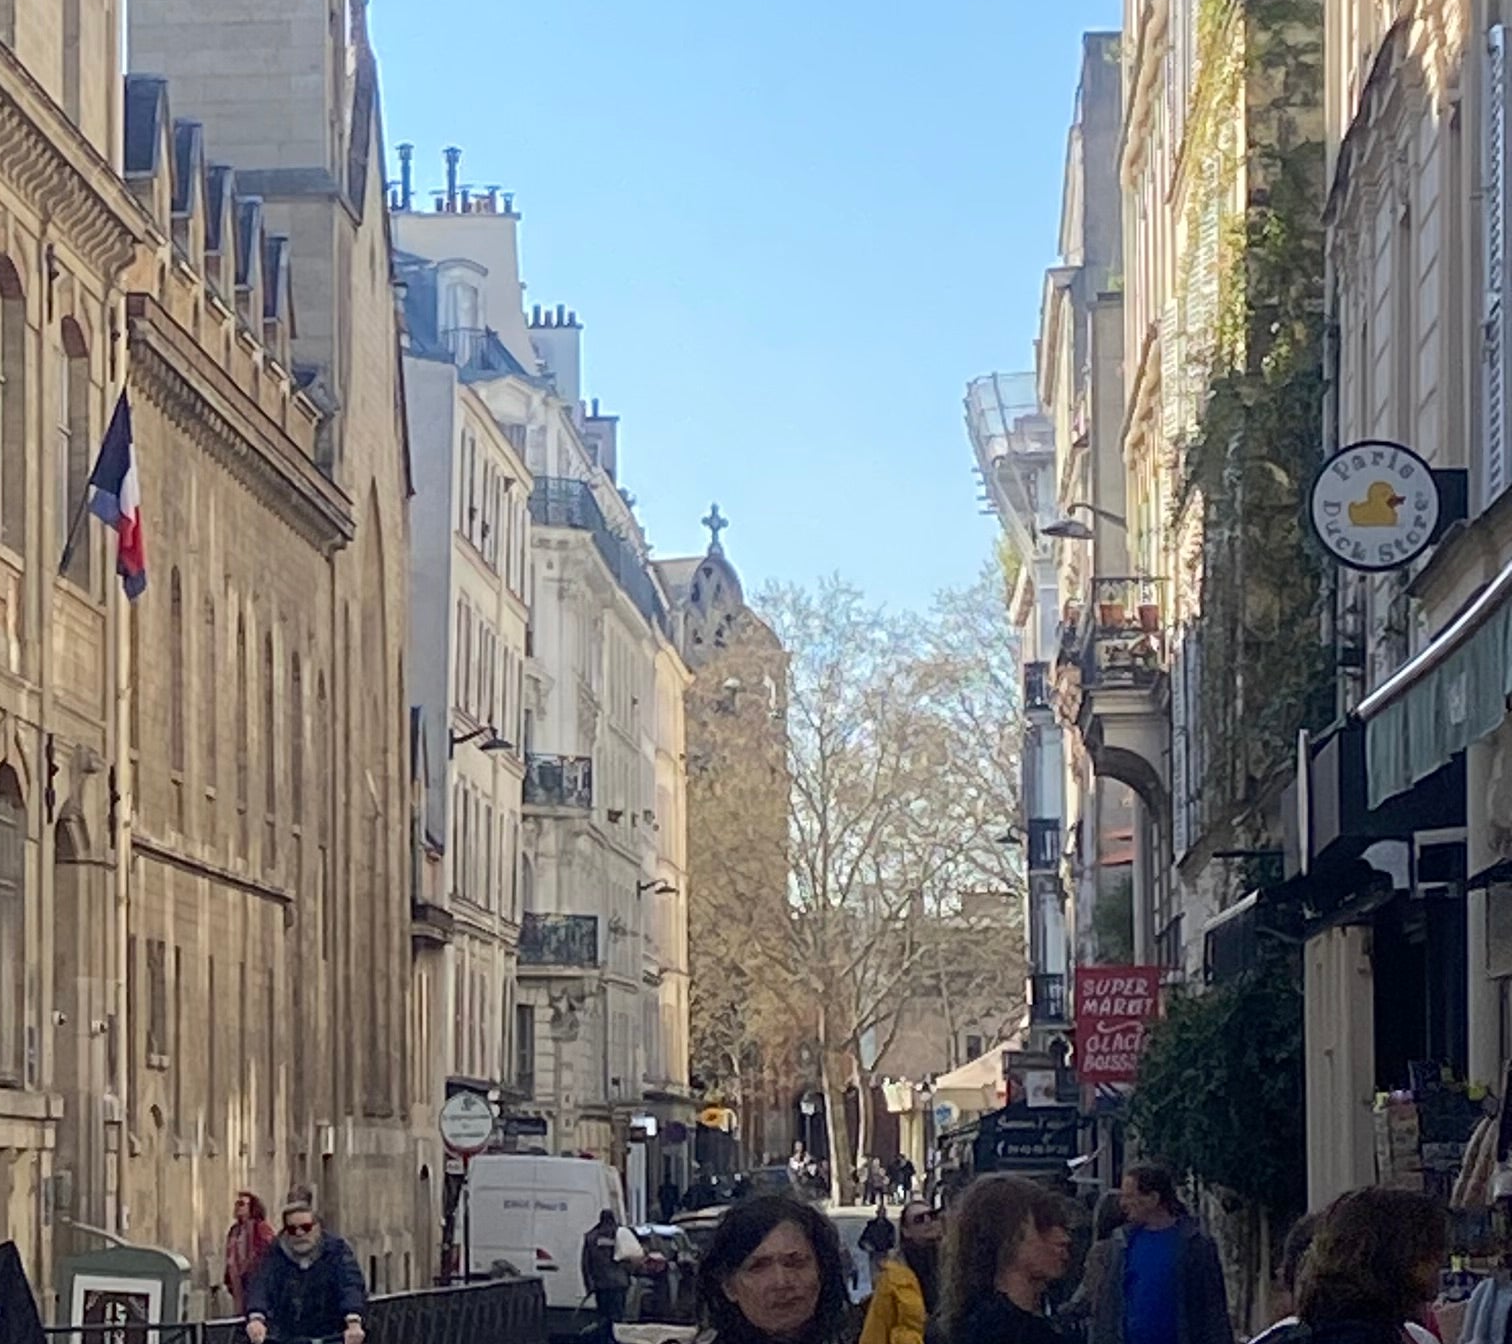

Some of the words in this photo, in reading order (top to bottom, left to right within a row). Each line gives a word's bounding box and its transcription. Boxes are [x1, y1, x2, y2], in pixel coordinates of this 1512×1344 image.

[1332, 451, 1415, 481] Paris
[1324, 500, 1367, 561] Duck
[1378, 497, 1429, 562] Store
[1083, 978, 1148, 996] SUPER
[1081, 997, 1154, 1016] MARKET
